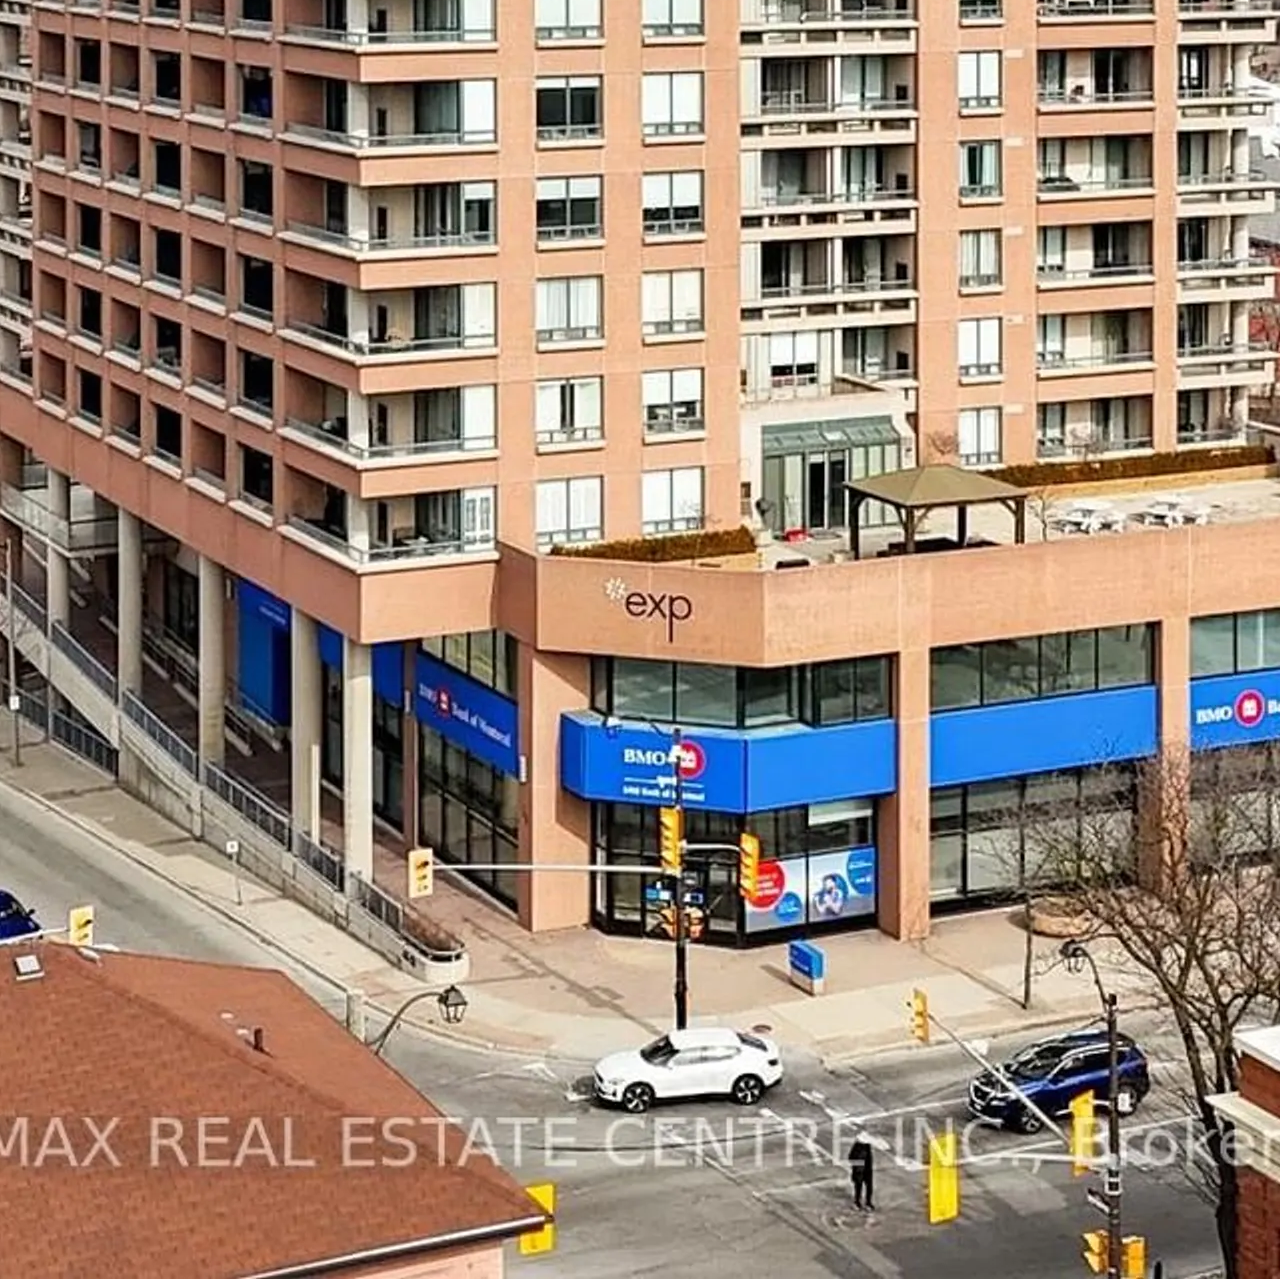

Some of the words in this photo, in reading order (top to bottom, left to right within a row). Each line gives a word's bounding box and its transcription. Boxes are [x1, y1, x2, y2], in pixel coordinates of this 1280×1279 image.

[624, 592, 693, 644] exp
[1195, 706, 1233, 725] BMO
[623, 748, 666, 767] BMO
